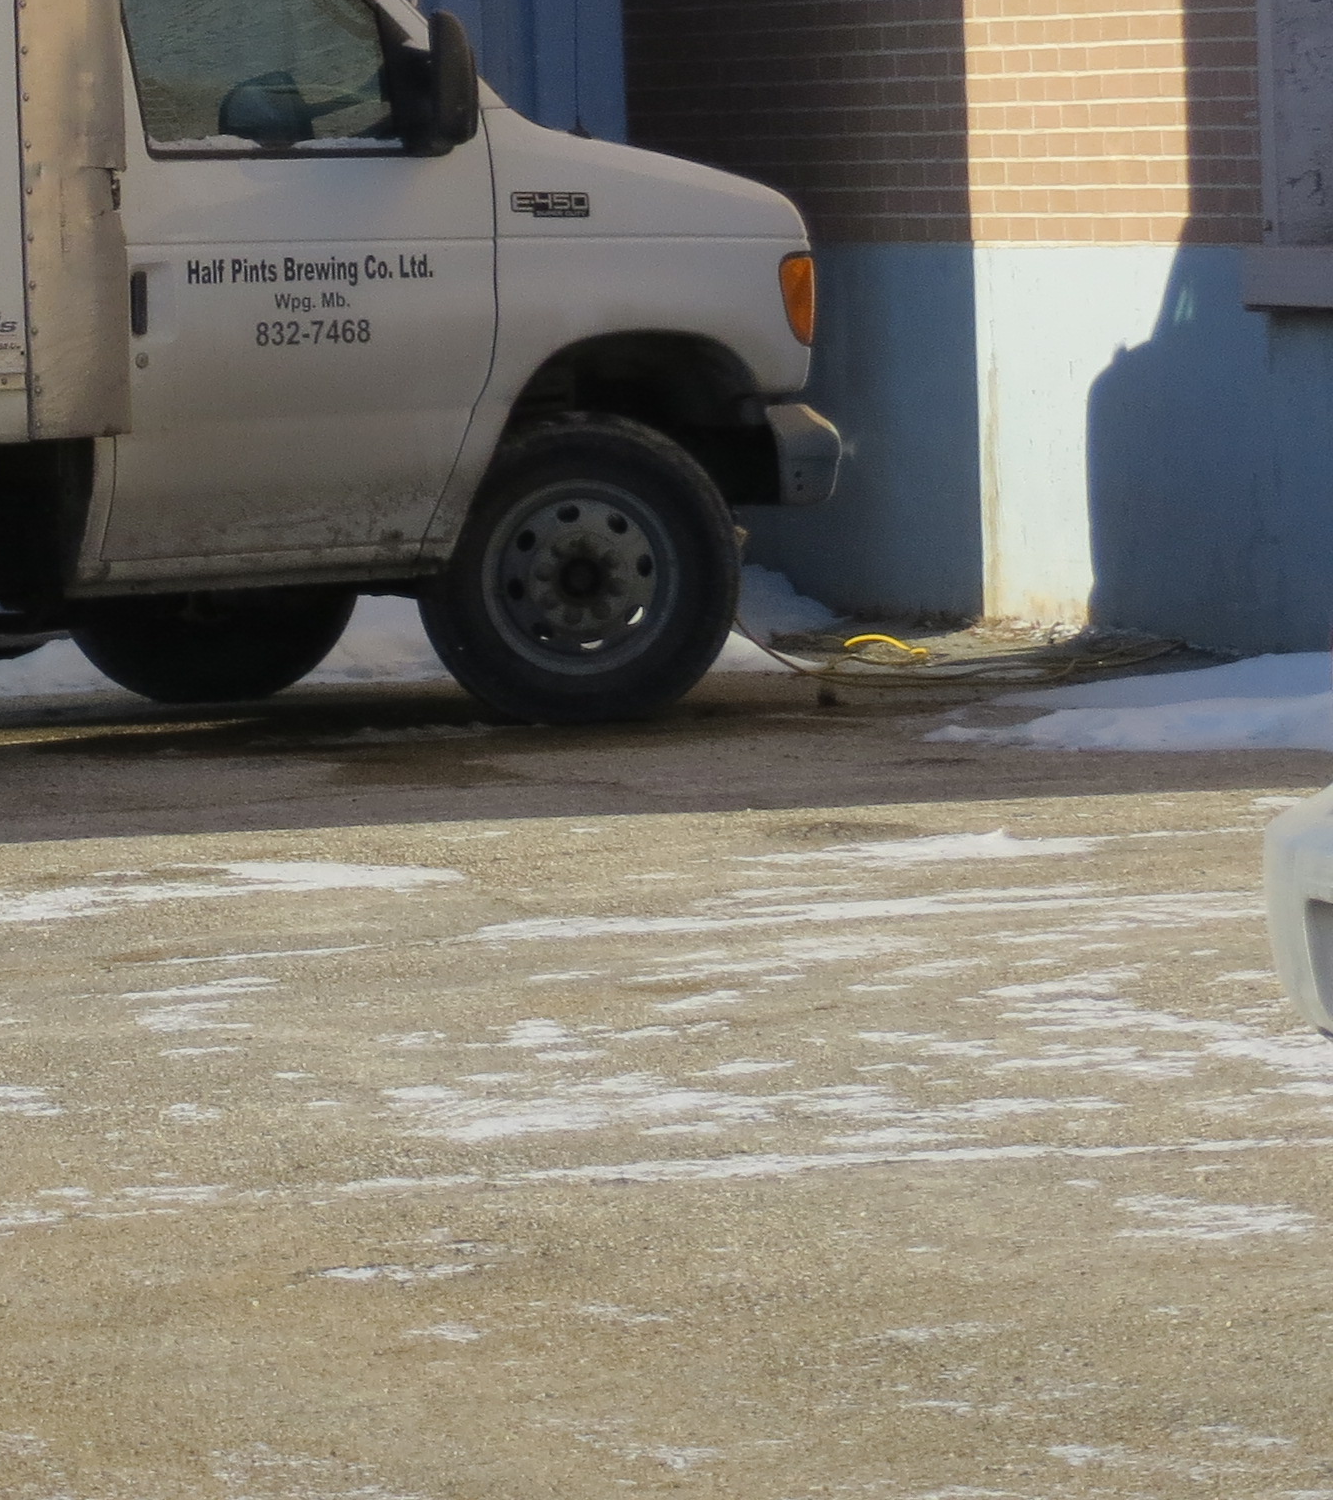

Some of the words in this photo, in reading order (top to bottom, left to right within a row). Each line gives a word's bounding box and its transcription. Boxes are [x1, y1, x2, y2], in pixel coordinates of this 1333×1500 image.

[188, 258, 225, 285] Half
[232, 258, 278, 284] Pints
[284, 257, 359, 287] Brewing
[365, 254, 393, 280] Co.
[400, 253, 434, 279] Ltd.
[275, 293, 317, 312] Wpg.
[322, 292, 351, 308] Mb.
[255, 319, 371, 347] 832-7468
